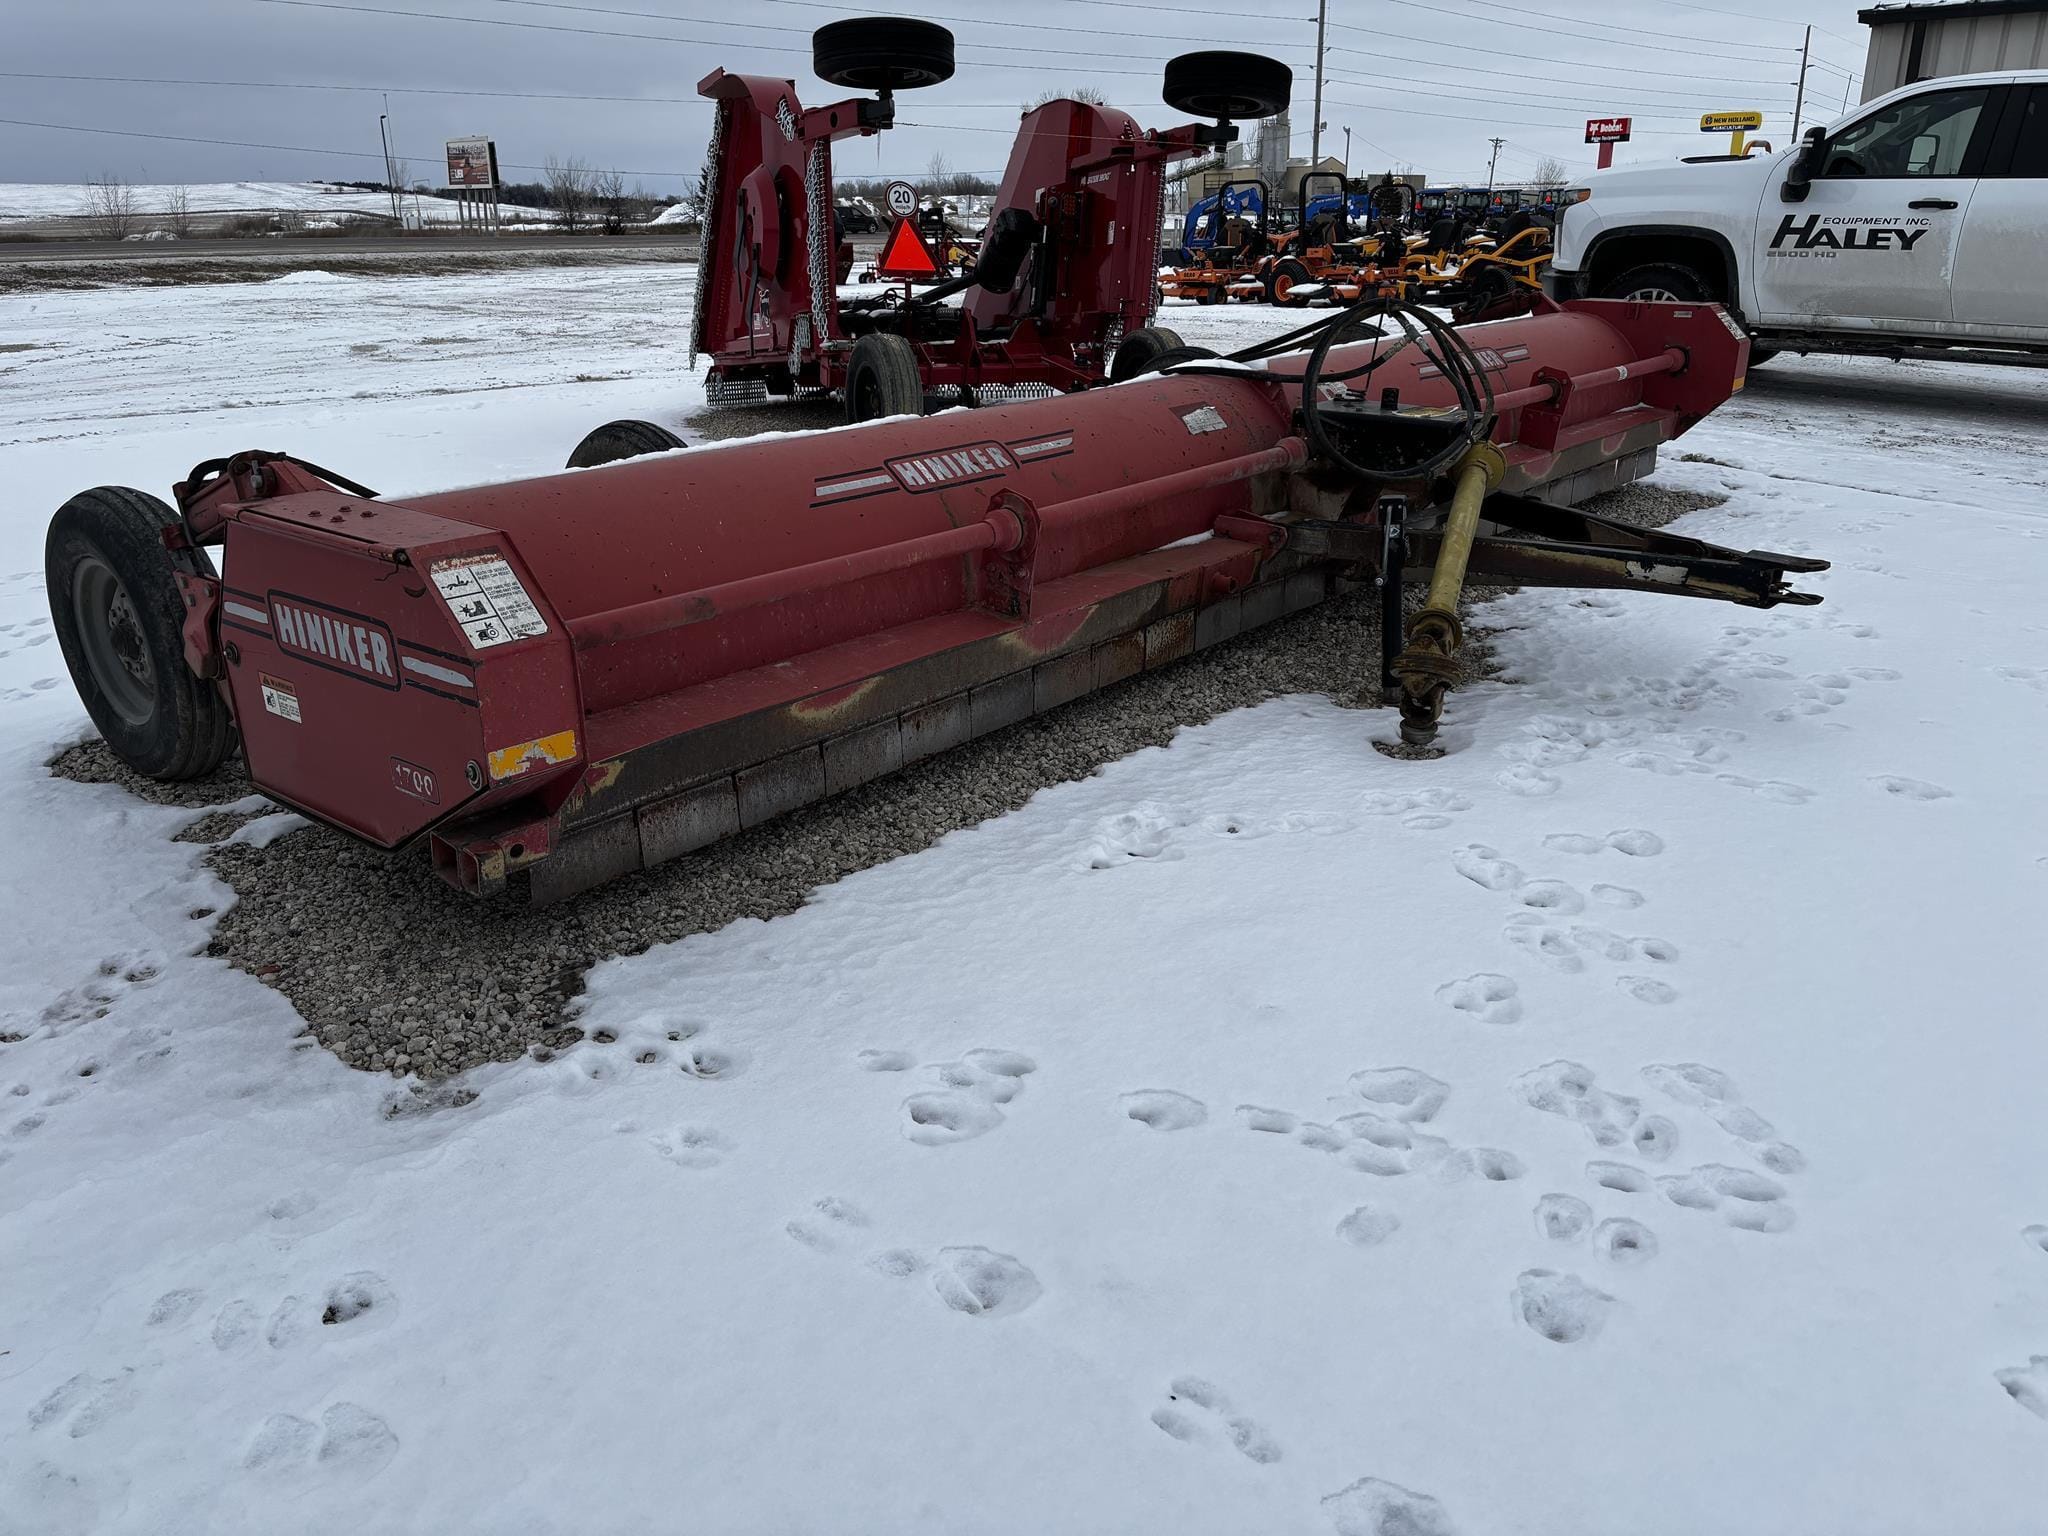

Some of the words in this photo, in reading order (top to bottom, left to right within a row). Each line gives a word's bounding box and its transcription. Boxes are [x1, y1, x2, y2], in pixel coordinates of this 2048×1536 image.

[894, 190, 910, 204] 20
[1769, 214, 1929, 250] HALEY
[1823, 217, 1901, 225] EQUIPMENT
[1905, 217, 1932, 226] INC.
[1767, 250, 1809, 258] 2500
[893, 447, 1012, 486] HINIKER
[274, 603, 393, 678] HINIKER
